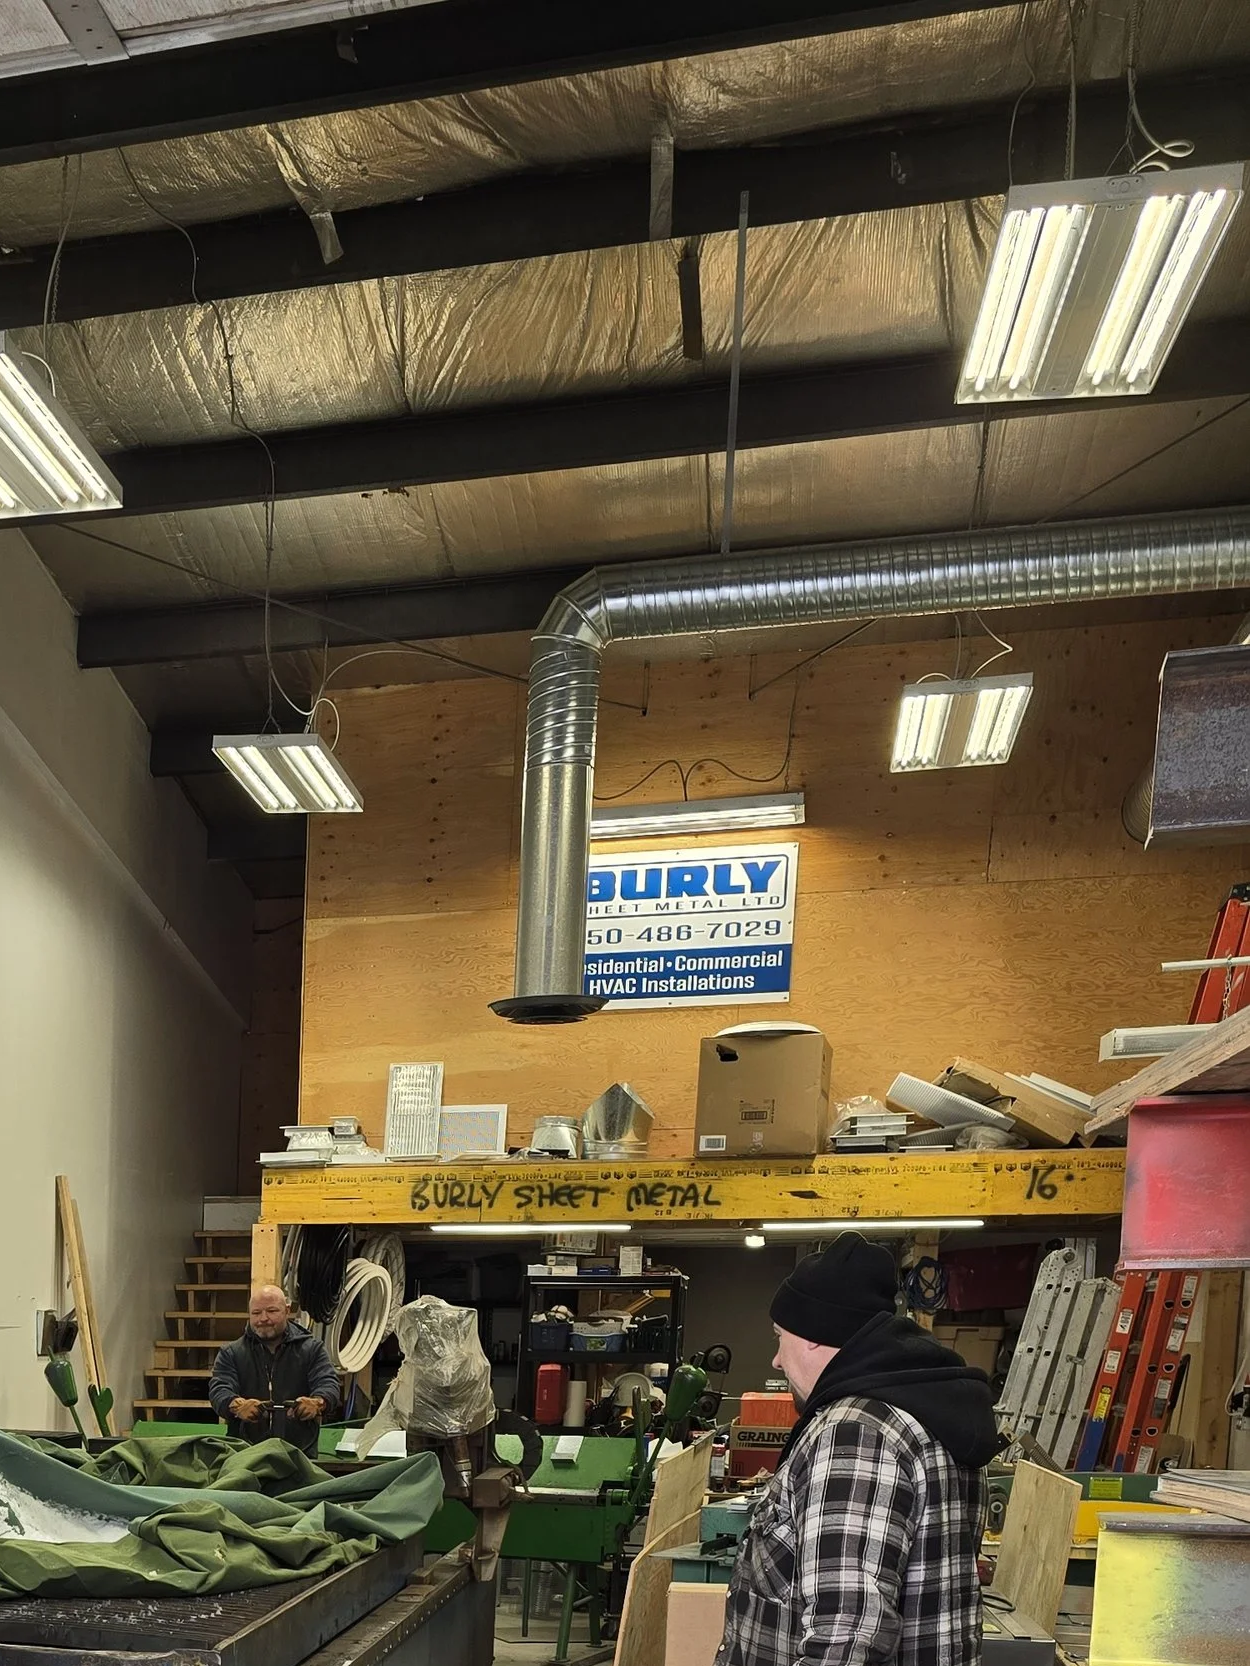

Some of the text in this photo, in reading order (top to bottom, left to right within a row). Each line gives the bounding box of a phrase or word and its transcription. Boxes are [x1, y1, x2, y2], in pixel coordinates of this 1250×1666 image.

[588, 860, 782, 902] BURLY
[588, 895, 780, 915] HEET METAL LTD
[587, 919, 781, 945] 50-486-7029
[674, 950, 783, 971] Commercial
[589, 974, 755, 995] HVAC Installations
[410, 1181, 722, 1212] BURLY SHEET METAL
[737, 1431, 790, 1443] GRAING
